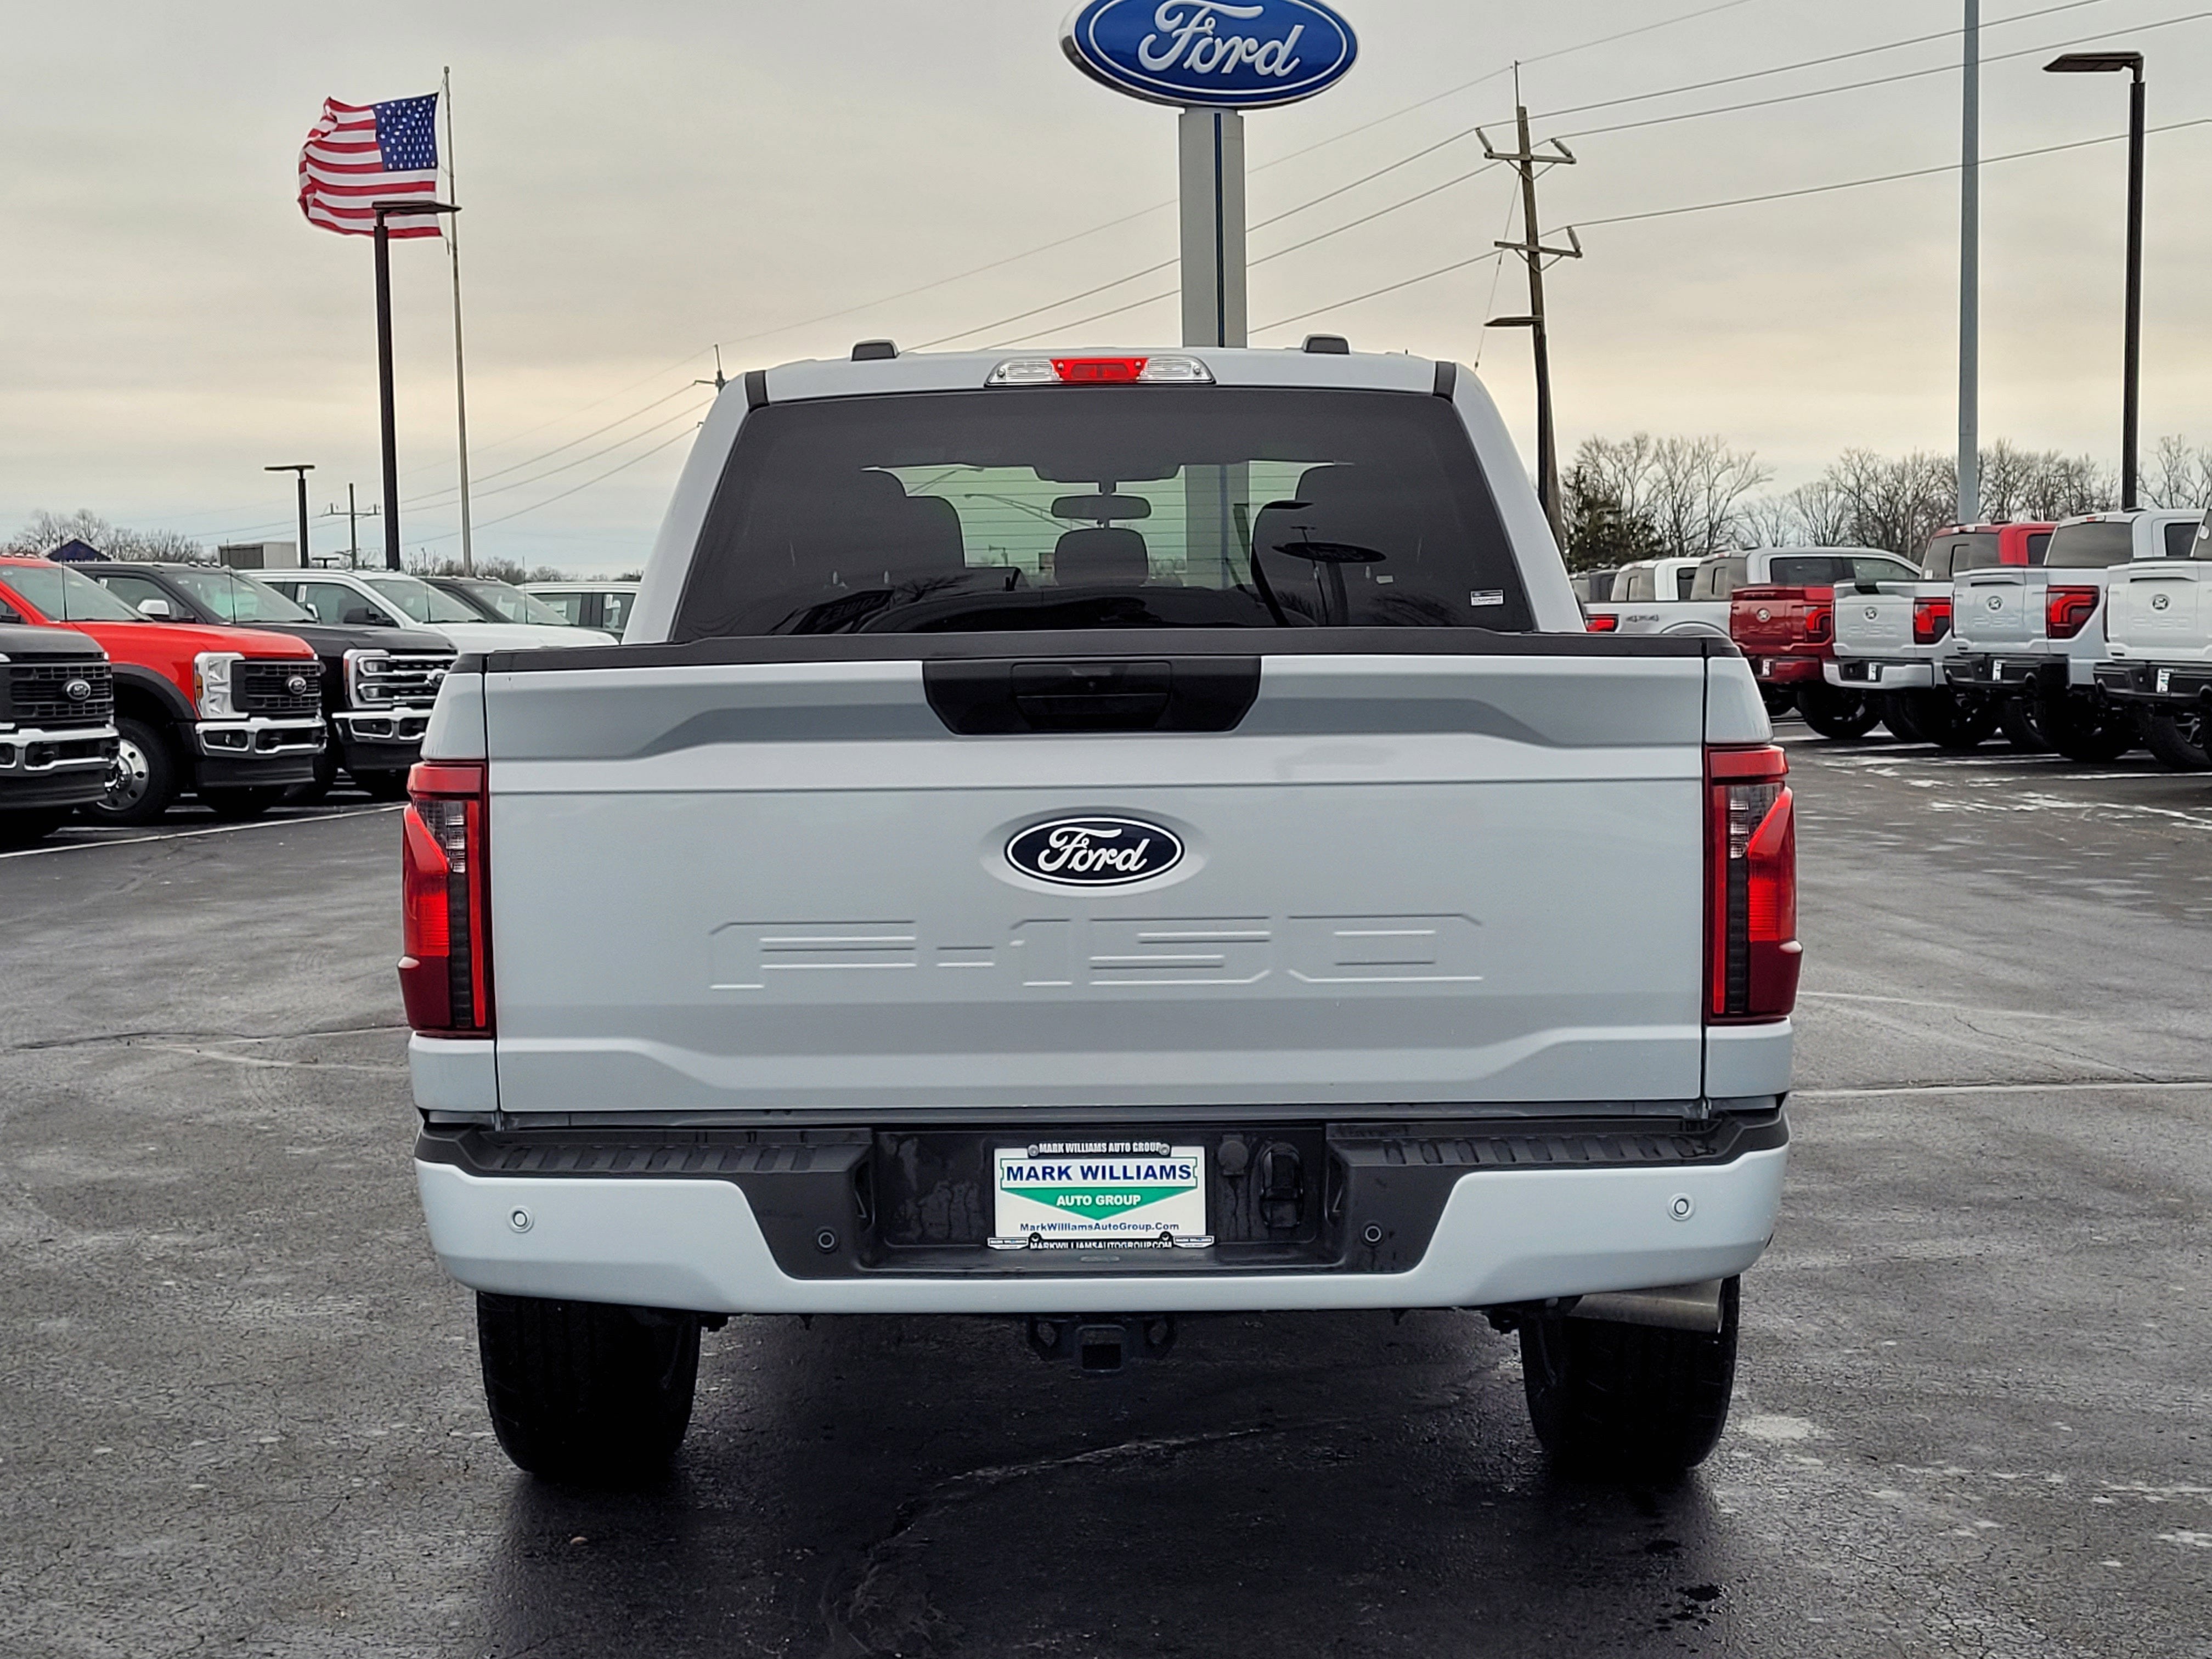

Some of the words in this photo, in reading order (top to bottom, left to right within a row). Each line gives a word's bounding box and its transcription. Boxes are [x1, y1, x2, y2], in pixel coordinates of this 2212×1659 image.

[1138, 0, 1305, 77] Ford
[1037, 827, 1150, 872] Ford
[710, 913, 1483, 988] F-150
[1039, 1143, 1064, 1153] MARK
[1065, 1143, 1107, 1153] WILLIAMS
[1108, 1143, 1131, 1153] AUTO
[1006, 1165, 1073, 1181] MARK
[1080, 1165, 1192, 1180] WILLIAMS
[1056, 1195, 1092, 1206] AUTO
[1096, 1195, 1141, 1206] GROUP
[1020, 1222, 1179, 1232] MarkWilliamsAutoGroup.Com
